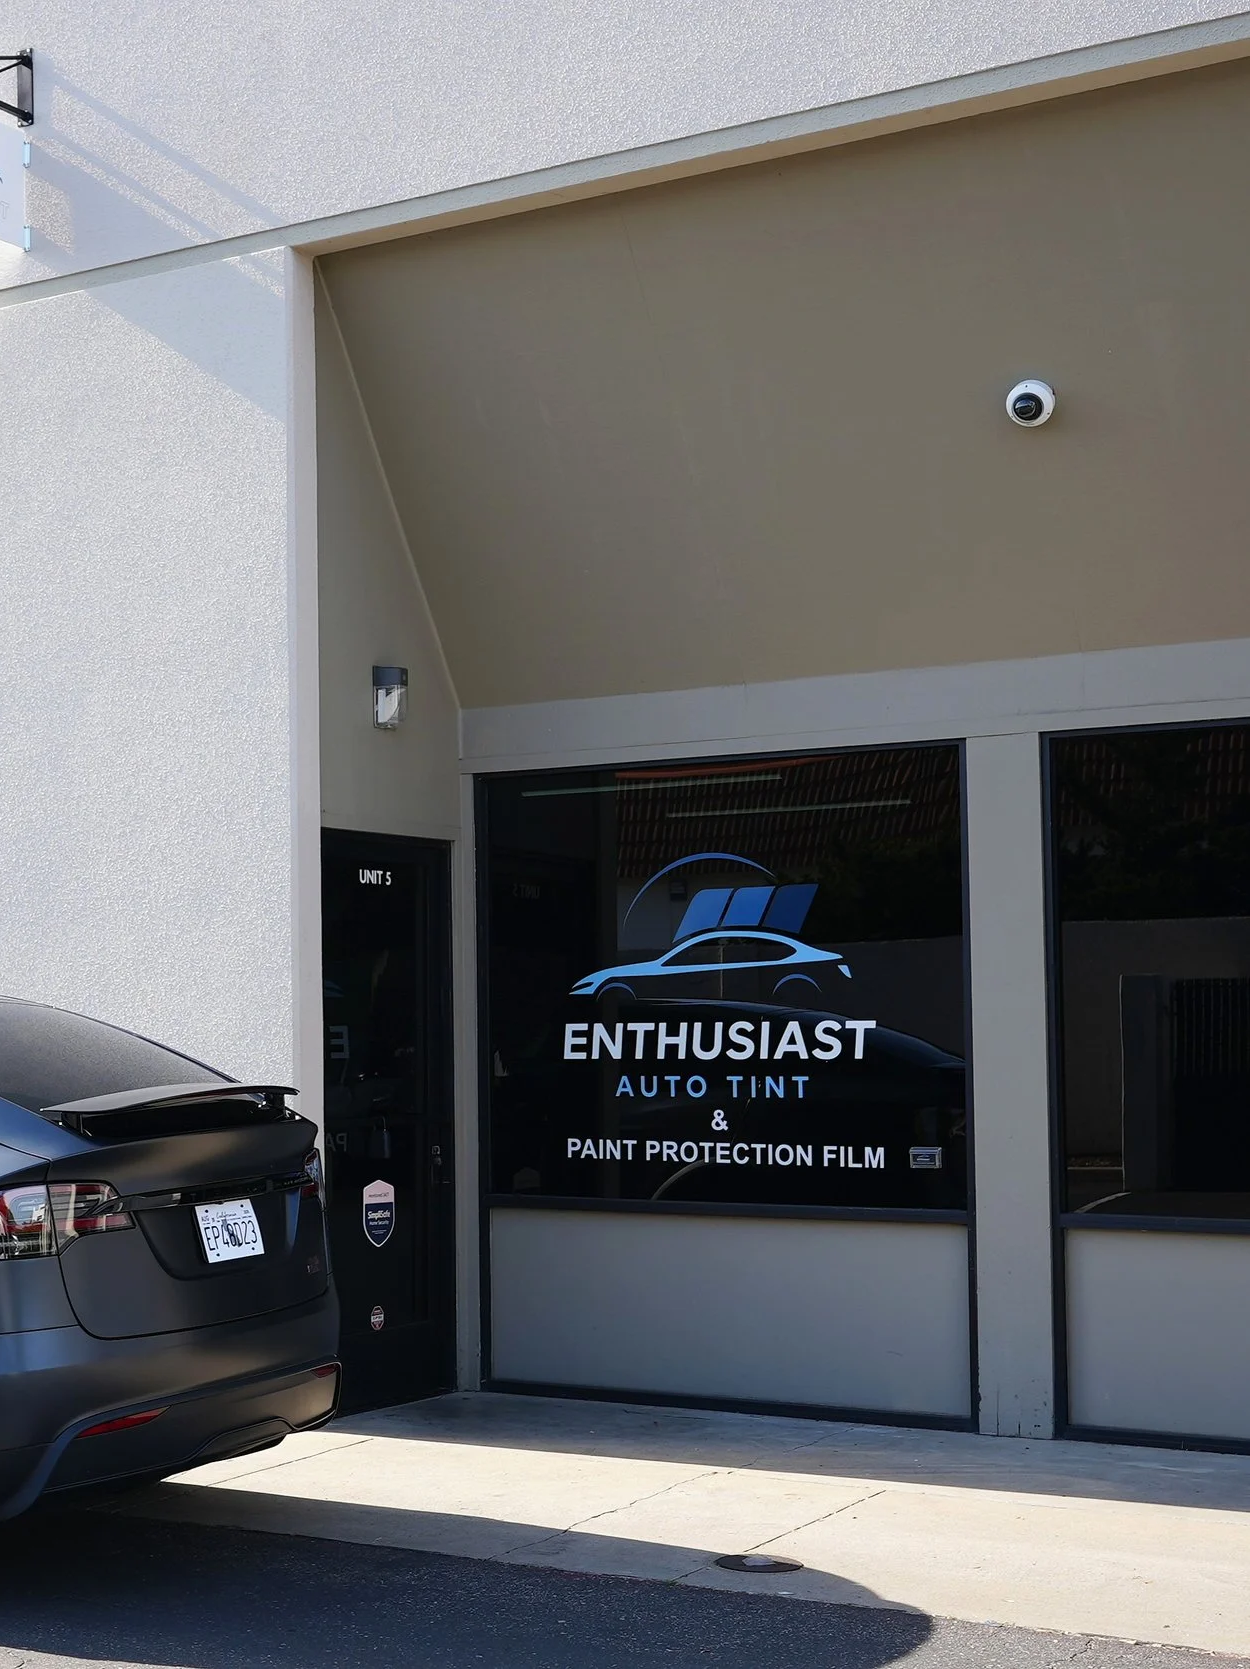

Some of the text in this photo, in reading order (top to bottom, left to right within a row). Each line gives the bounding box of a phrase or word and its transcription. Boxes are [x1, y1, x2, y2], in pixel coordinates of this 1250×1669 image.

[359, 868, 392, 886] UNIT 5
[563, 1020, 876, 1061] ENTHUSIAST
[615, 1075, 810, 1099] AUTO TINT
[711, 1109, 729, 1132] &
[566, 1138, 885, 1169] PAINT PROTECTION FILM
